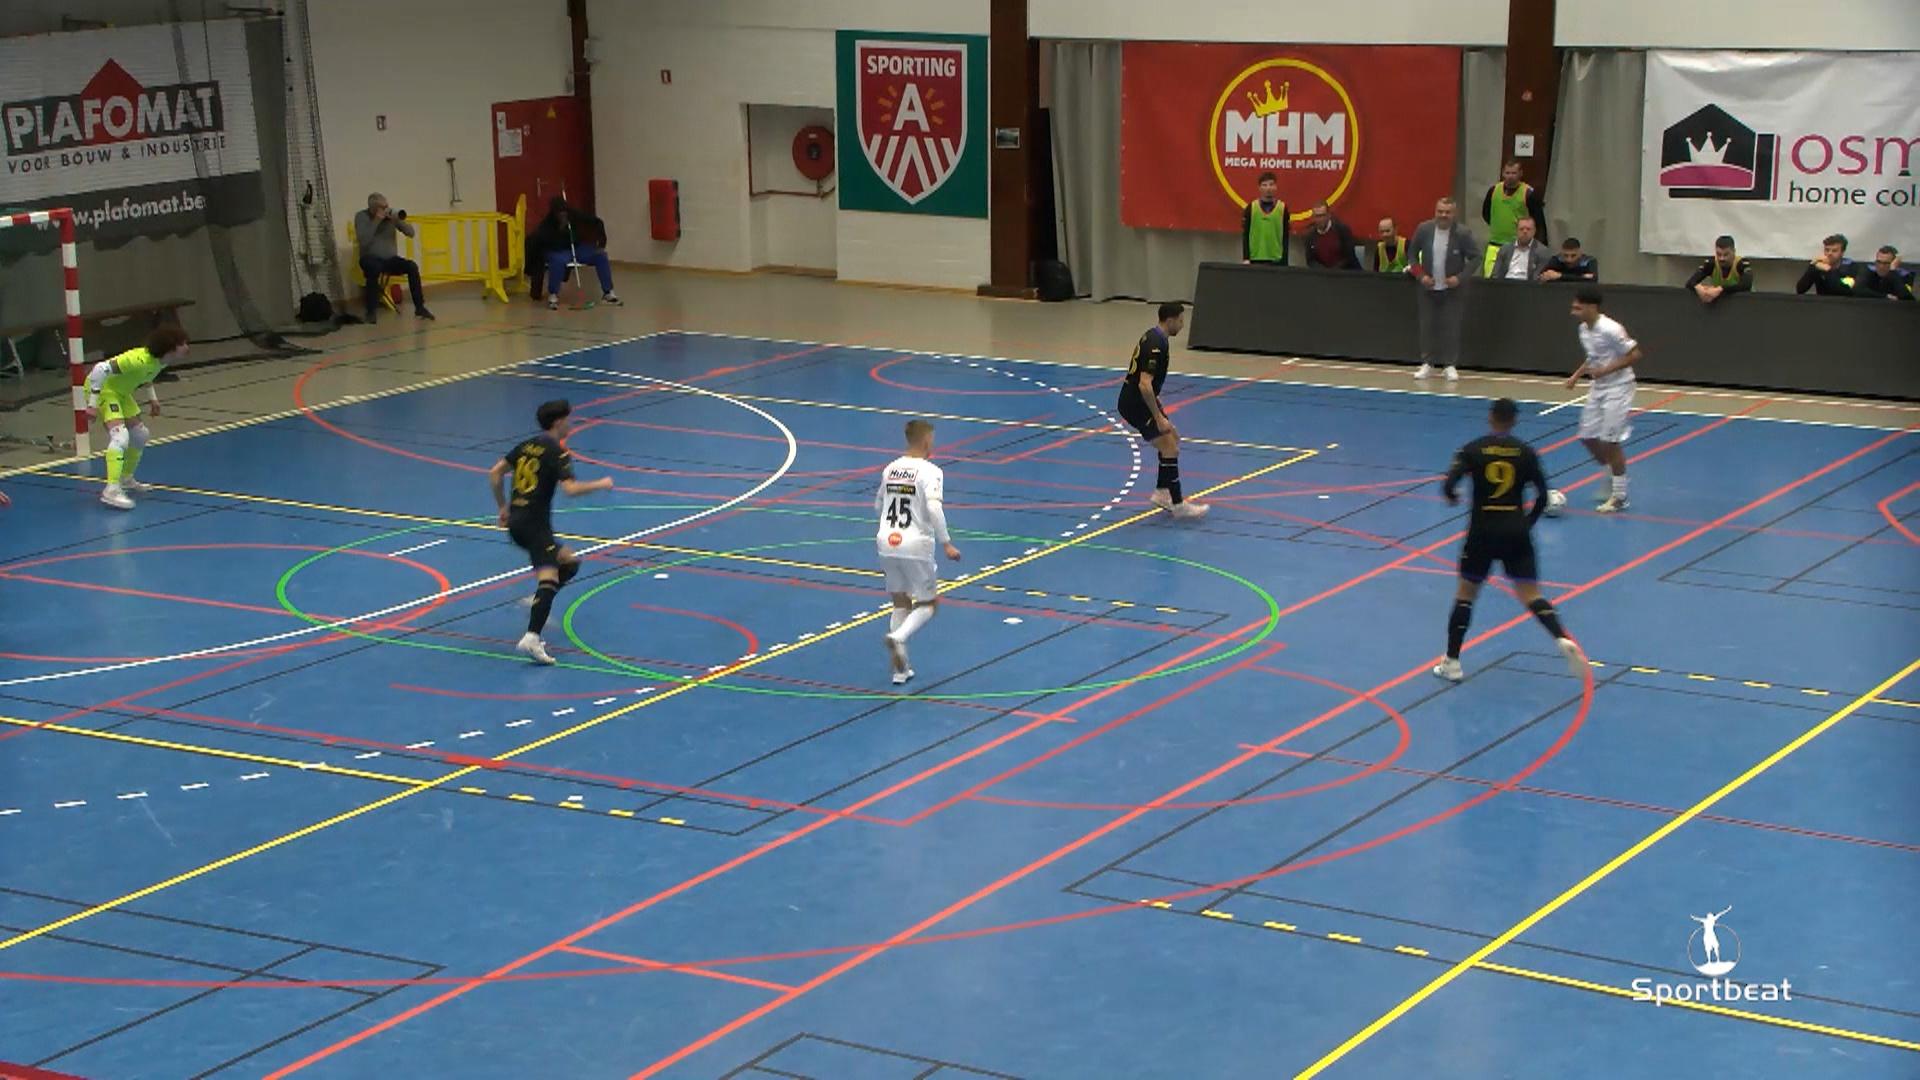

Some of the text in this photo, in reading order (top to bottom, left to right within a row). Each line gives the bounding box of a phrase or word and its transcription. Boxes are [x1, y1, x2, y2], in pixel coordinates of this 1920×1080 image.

[867, 55, 956, 77] SPORTING
[7, 87, 214, 149] PLAFOMAT
[893, 83, 930, 132] A
[1225, 110, 1345, 155] MHM
[8, 135, 226, 174] VOOR BOUW & INDUSTRIE
[1225, 157, 1344, 170] MEGA HOME MARKET
[1788, 180, 1866, 205] home
[1484, 460, 1516, 499] 9
[886, 497, 912, 529] 45
